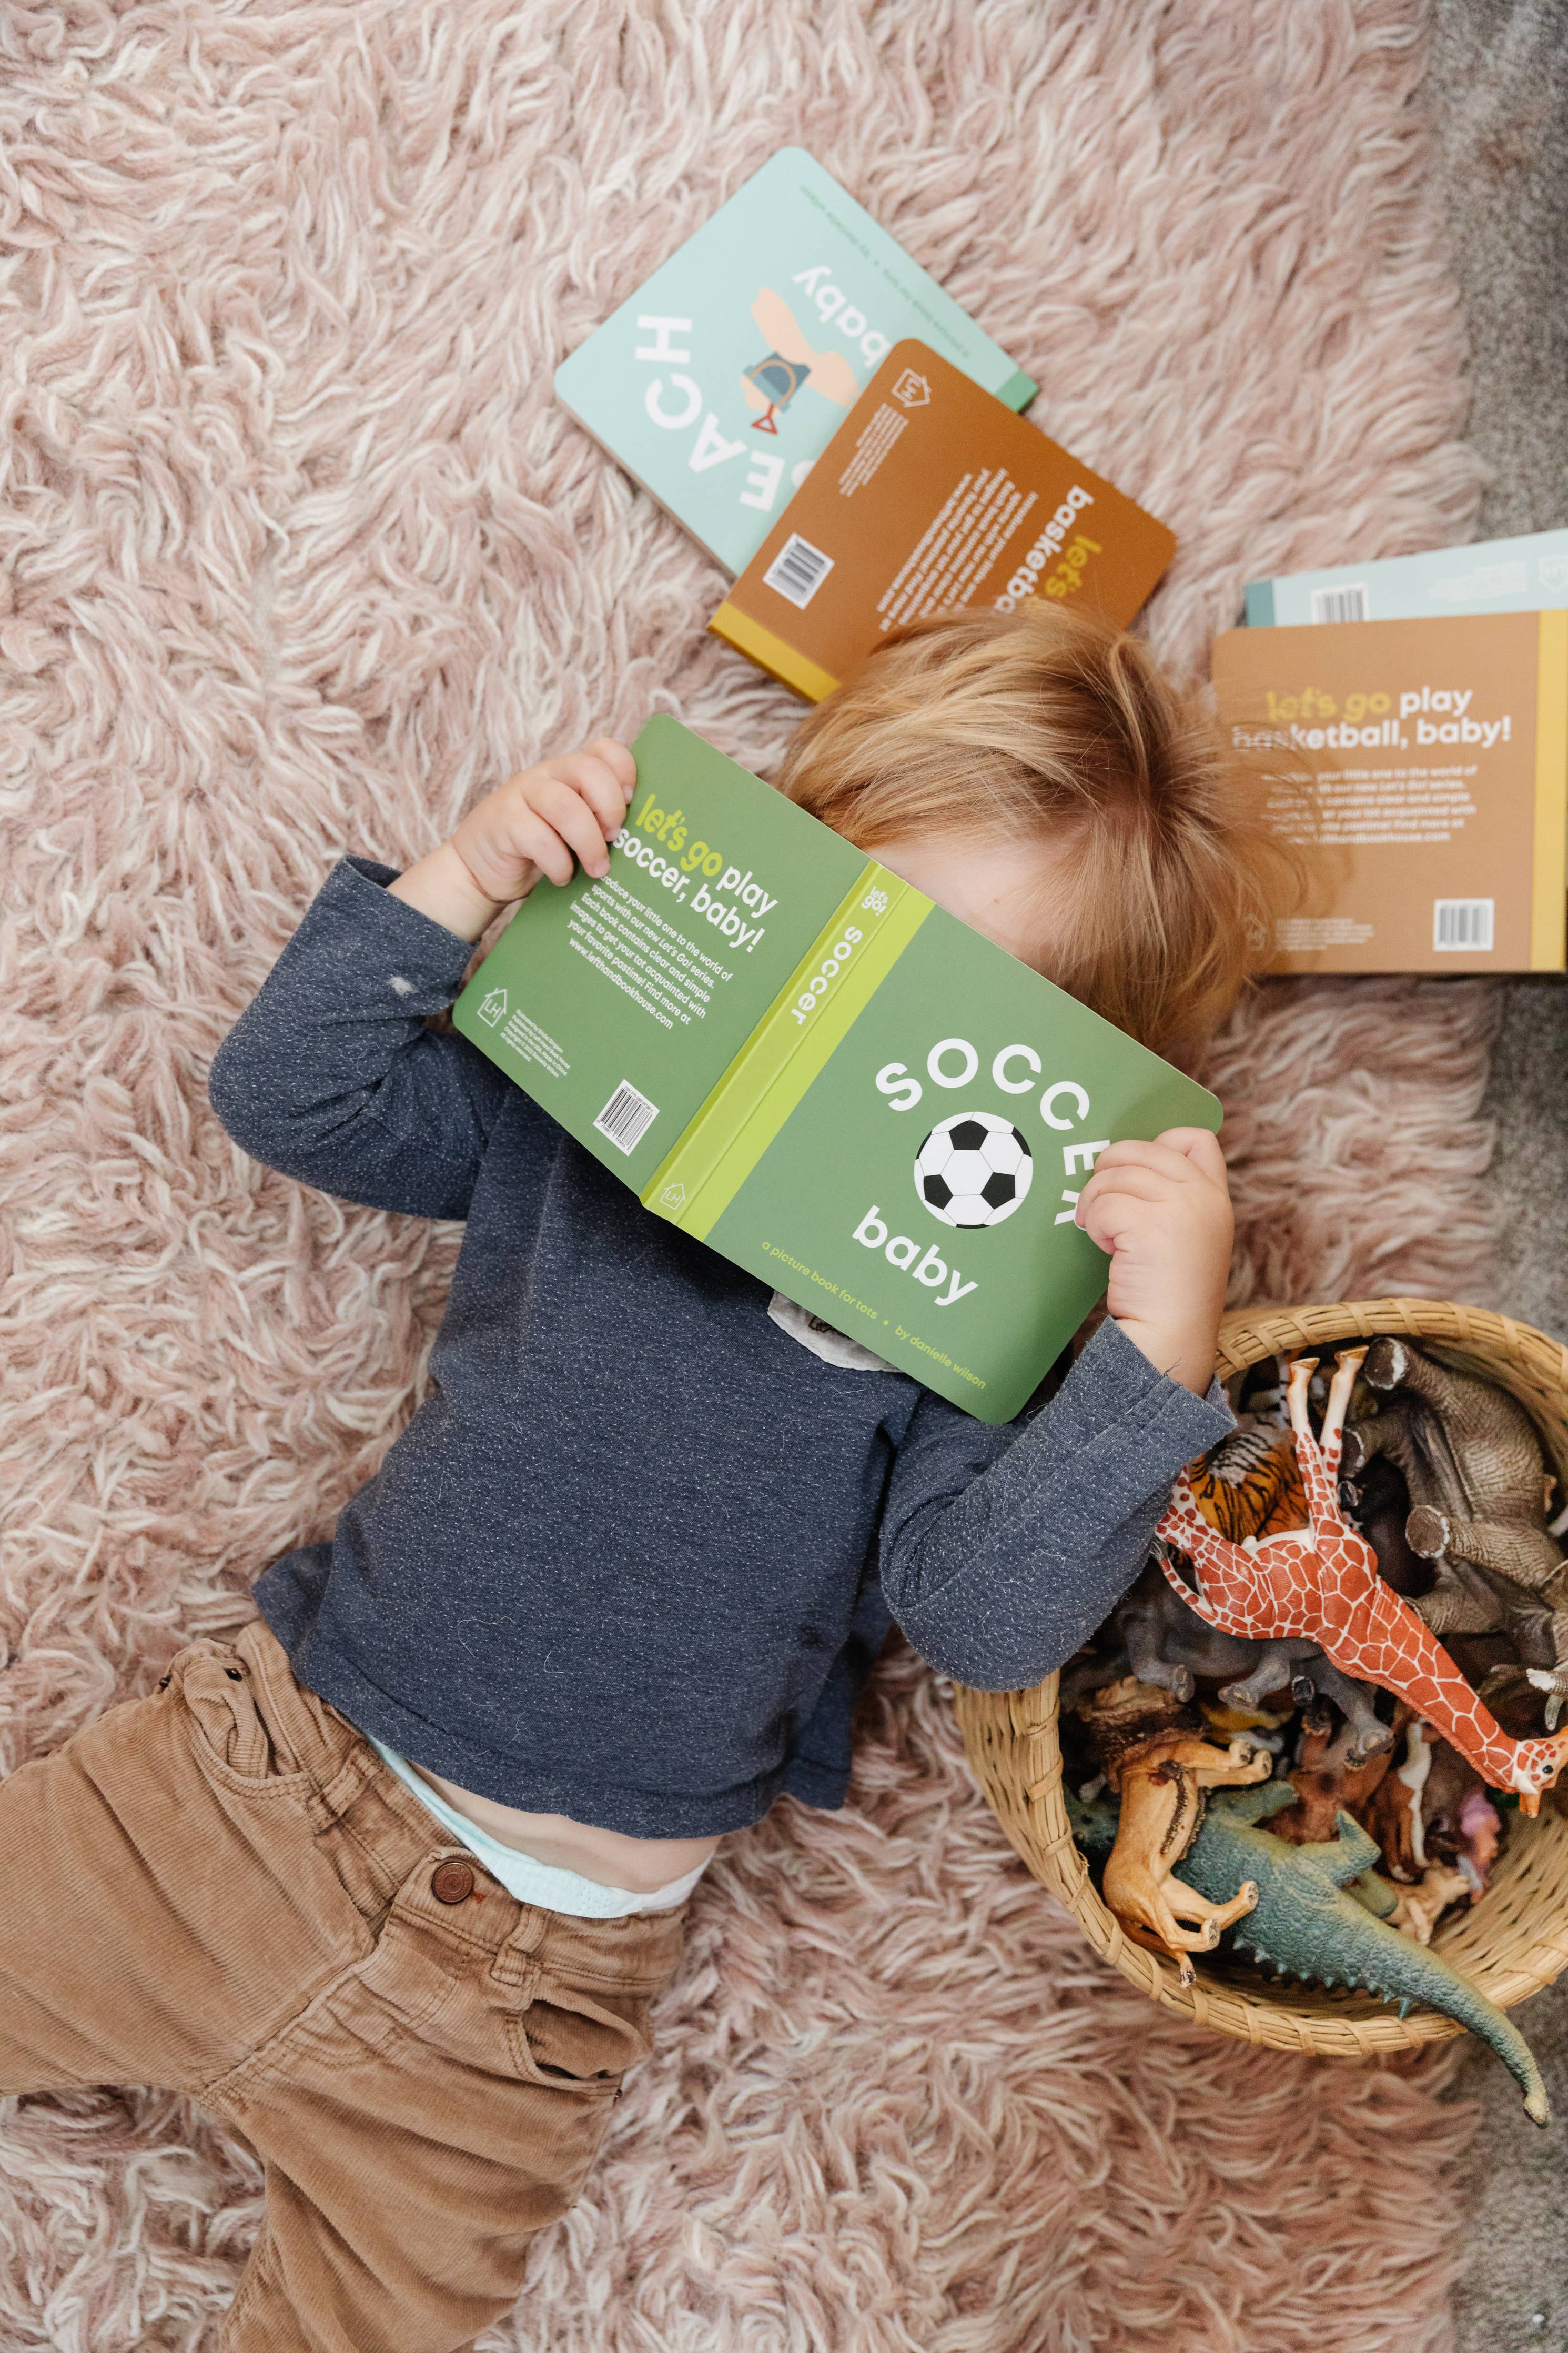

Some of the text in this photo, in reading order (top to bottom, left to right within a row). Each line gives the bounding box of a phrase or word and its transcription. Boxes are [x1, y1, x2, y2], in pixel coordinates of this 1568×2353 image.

[793, 265, 892, 368] baby
[634, 315, 816, 512] EACH
[994, 485, 1095, 614] basketba
[1045, 535, 1102, 597] let's
[1344, 689, 1391, 722] go
[1399, 685, 1473, 719] play
[1415, 715, 1511, 748] baby!
[613, 828, 765, 952] soccer, baby!
[635, 793, 778, 918] let's go play
[862, 896, 886, 917] go!
[870, 886, 888, 904] let's
[566, 919, 691, 1025] your favorite pastime! Find more at
[570, 900, 706, 1018] images to get your tot acquainted with
[581, 892, 710, 1002] Each book contains clear and simple
[591, 884, 714, 989] sports with our new Let's Go! series.
[602, 876, 733, 981] roduce your little one to the world of
[791, 926, 862, 1026] soccer
[484, 998, 502, 1019] LH
[569, 937, 673, 1029] www.lefthandbookhouse.com
[665, 1190, 681, 1204] LH
[852, 1205, 979, 1306] baby
[762, 1241, 985, 1389] a picture book for tots by danielle wilson
